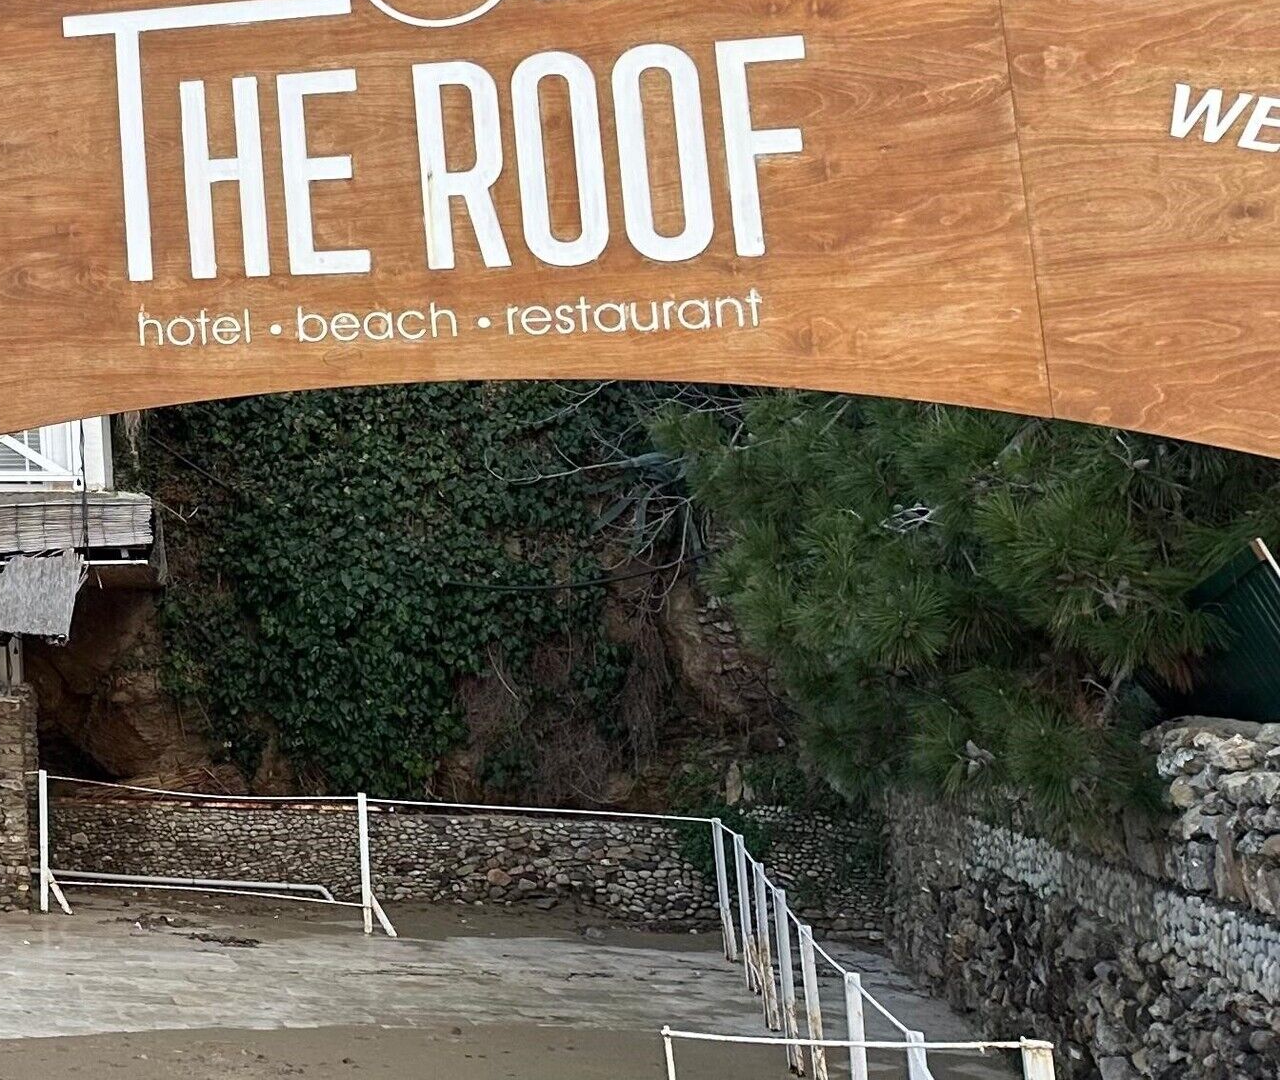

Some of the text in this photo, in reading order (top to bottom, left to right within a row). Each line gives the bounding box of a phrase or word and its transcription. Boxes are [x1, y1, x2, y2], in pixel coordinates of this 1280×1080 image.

[411, 34, 807, 271] ROOF
[1169, 80, 1280, 153] WE
[137, 287, 763, 347] hotel beach restaurant
